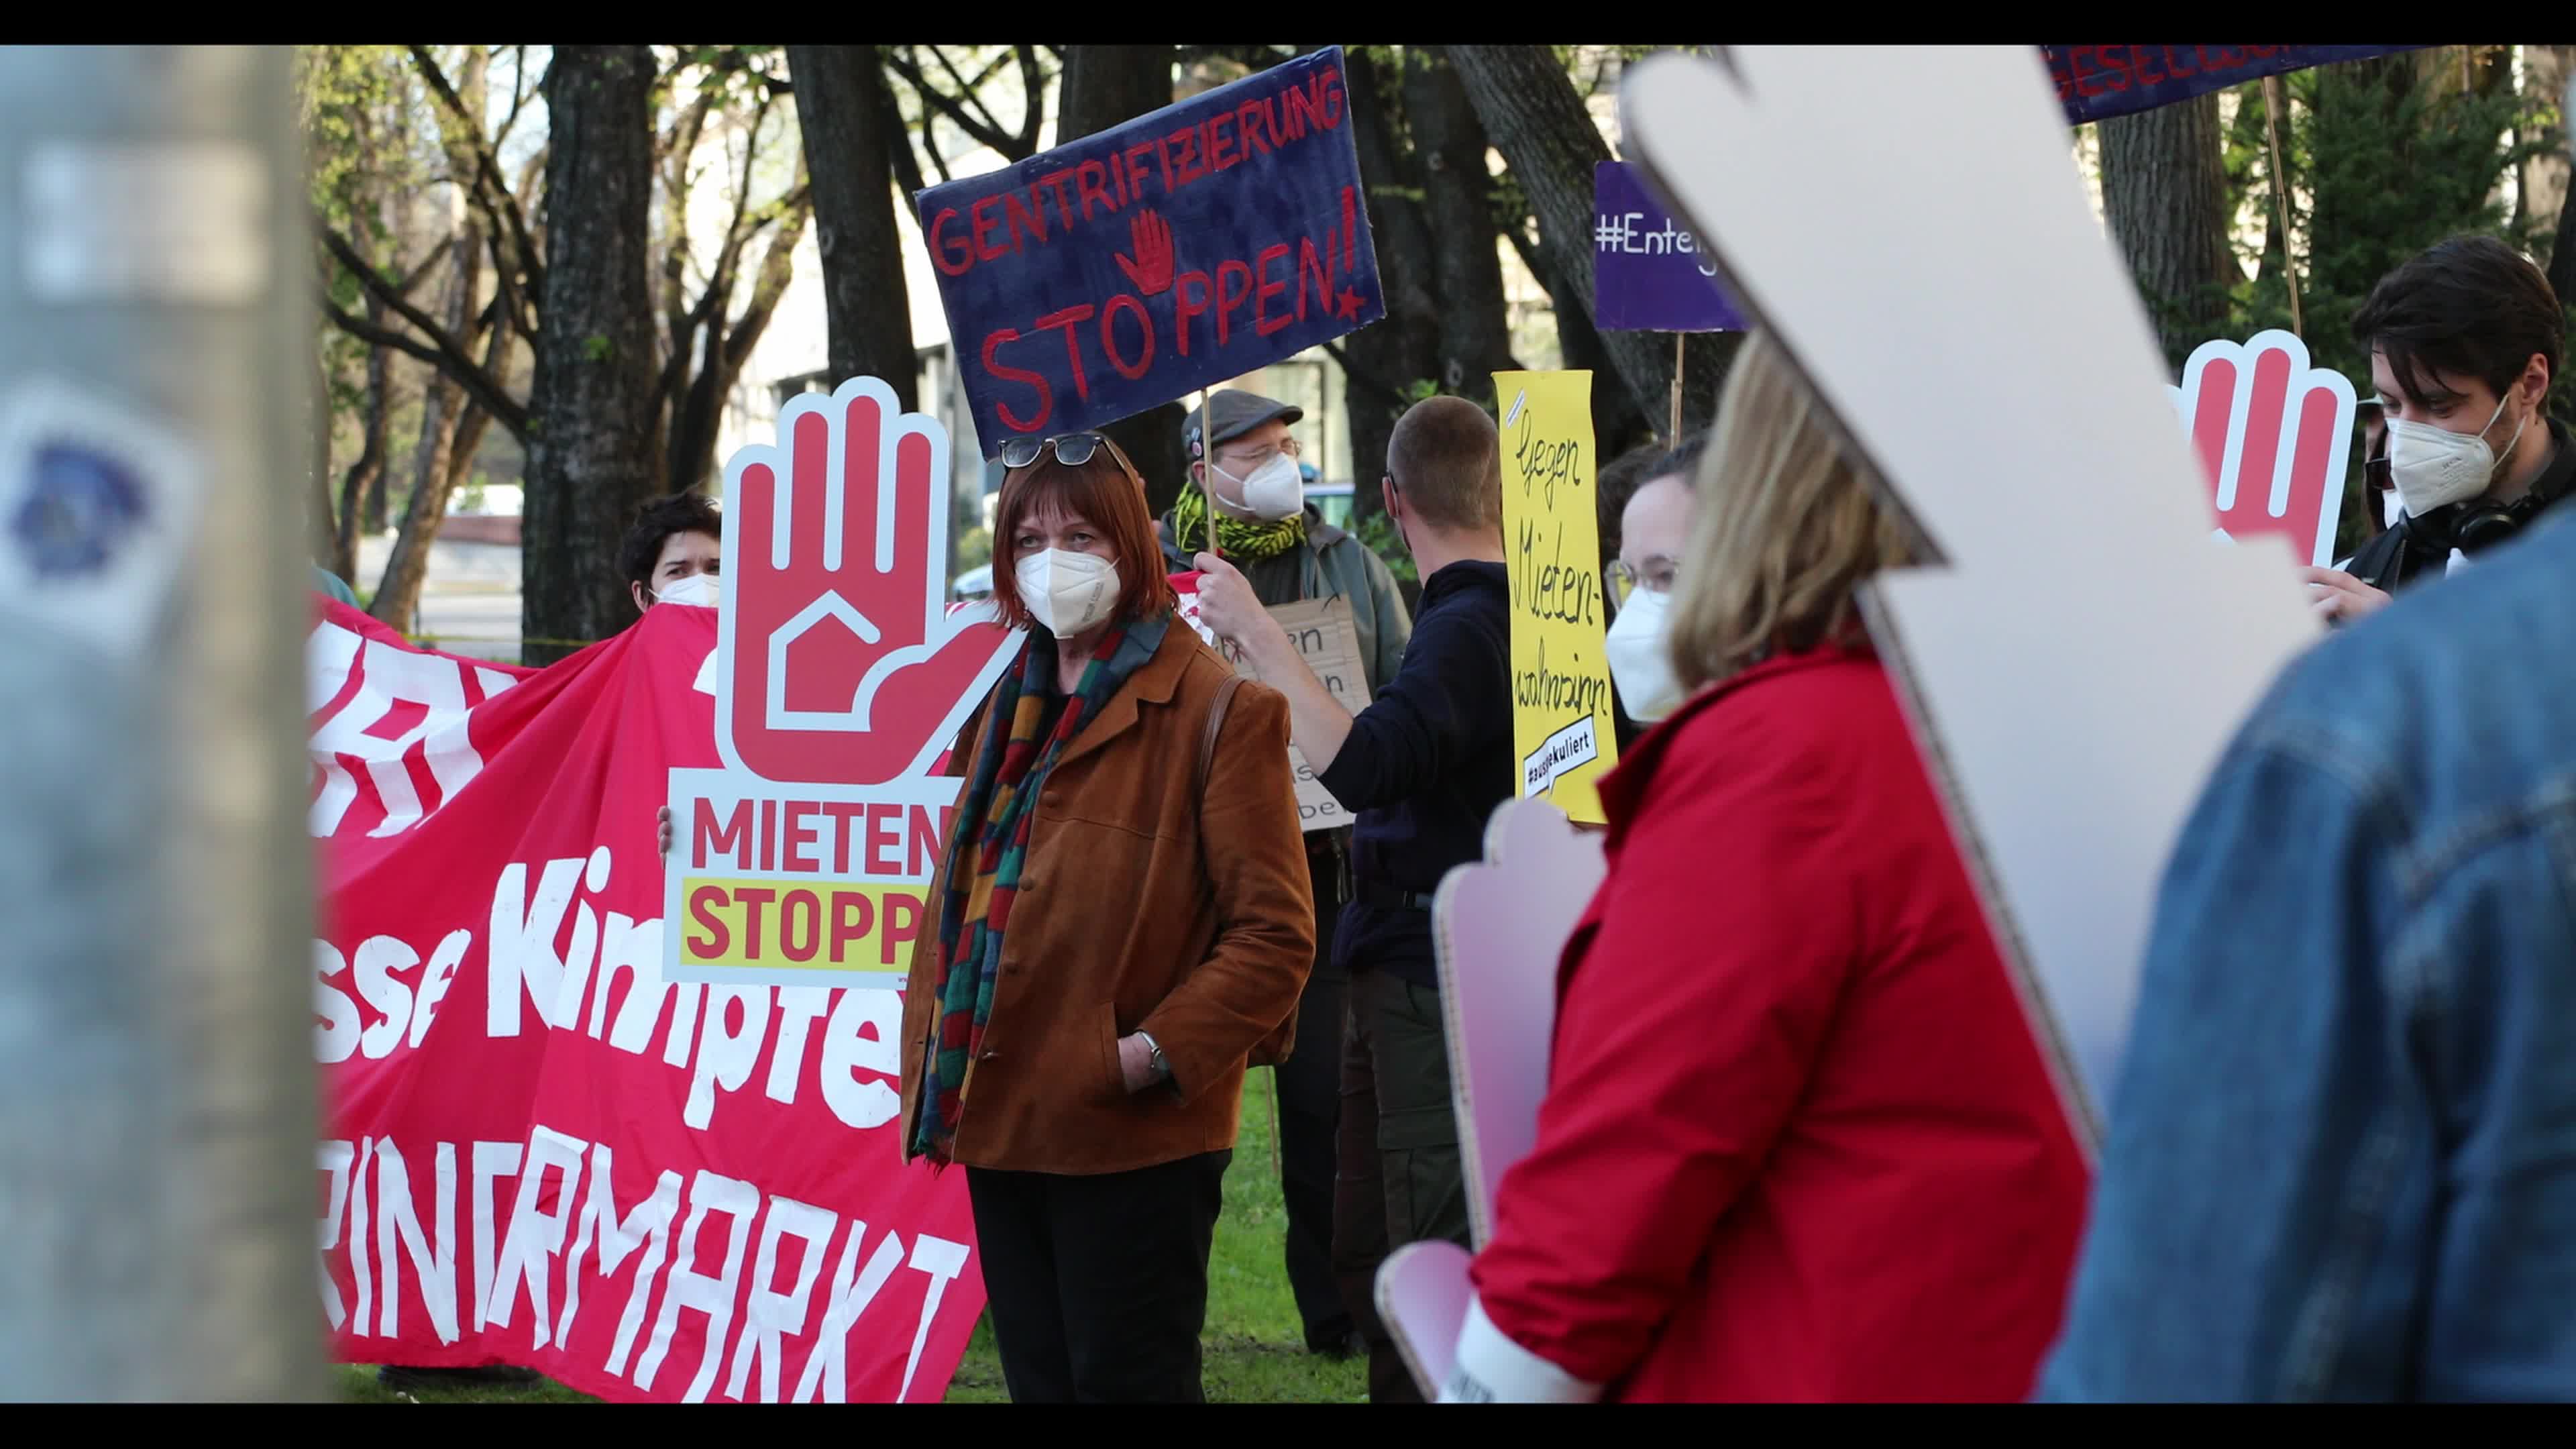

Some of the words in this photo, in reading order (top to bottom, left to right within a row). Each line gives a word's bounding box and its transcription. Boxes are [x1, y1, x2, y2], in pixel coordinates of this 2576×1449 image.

[929, 64, 1342, 276] GENTRIFIZIERUNG
[981, 185, 1356, 433] STOPPEN!
[1516, 407, 1581, 513] Gegen
[1513, 517, 1601, 627] Mieten-
[692, 797, 957, 876] MIETEN
[686, 885, 924, 964] STOPP
